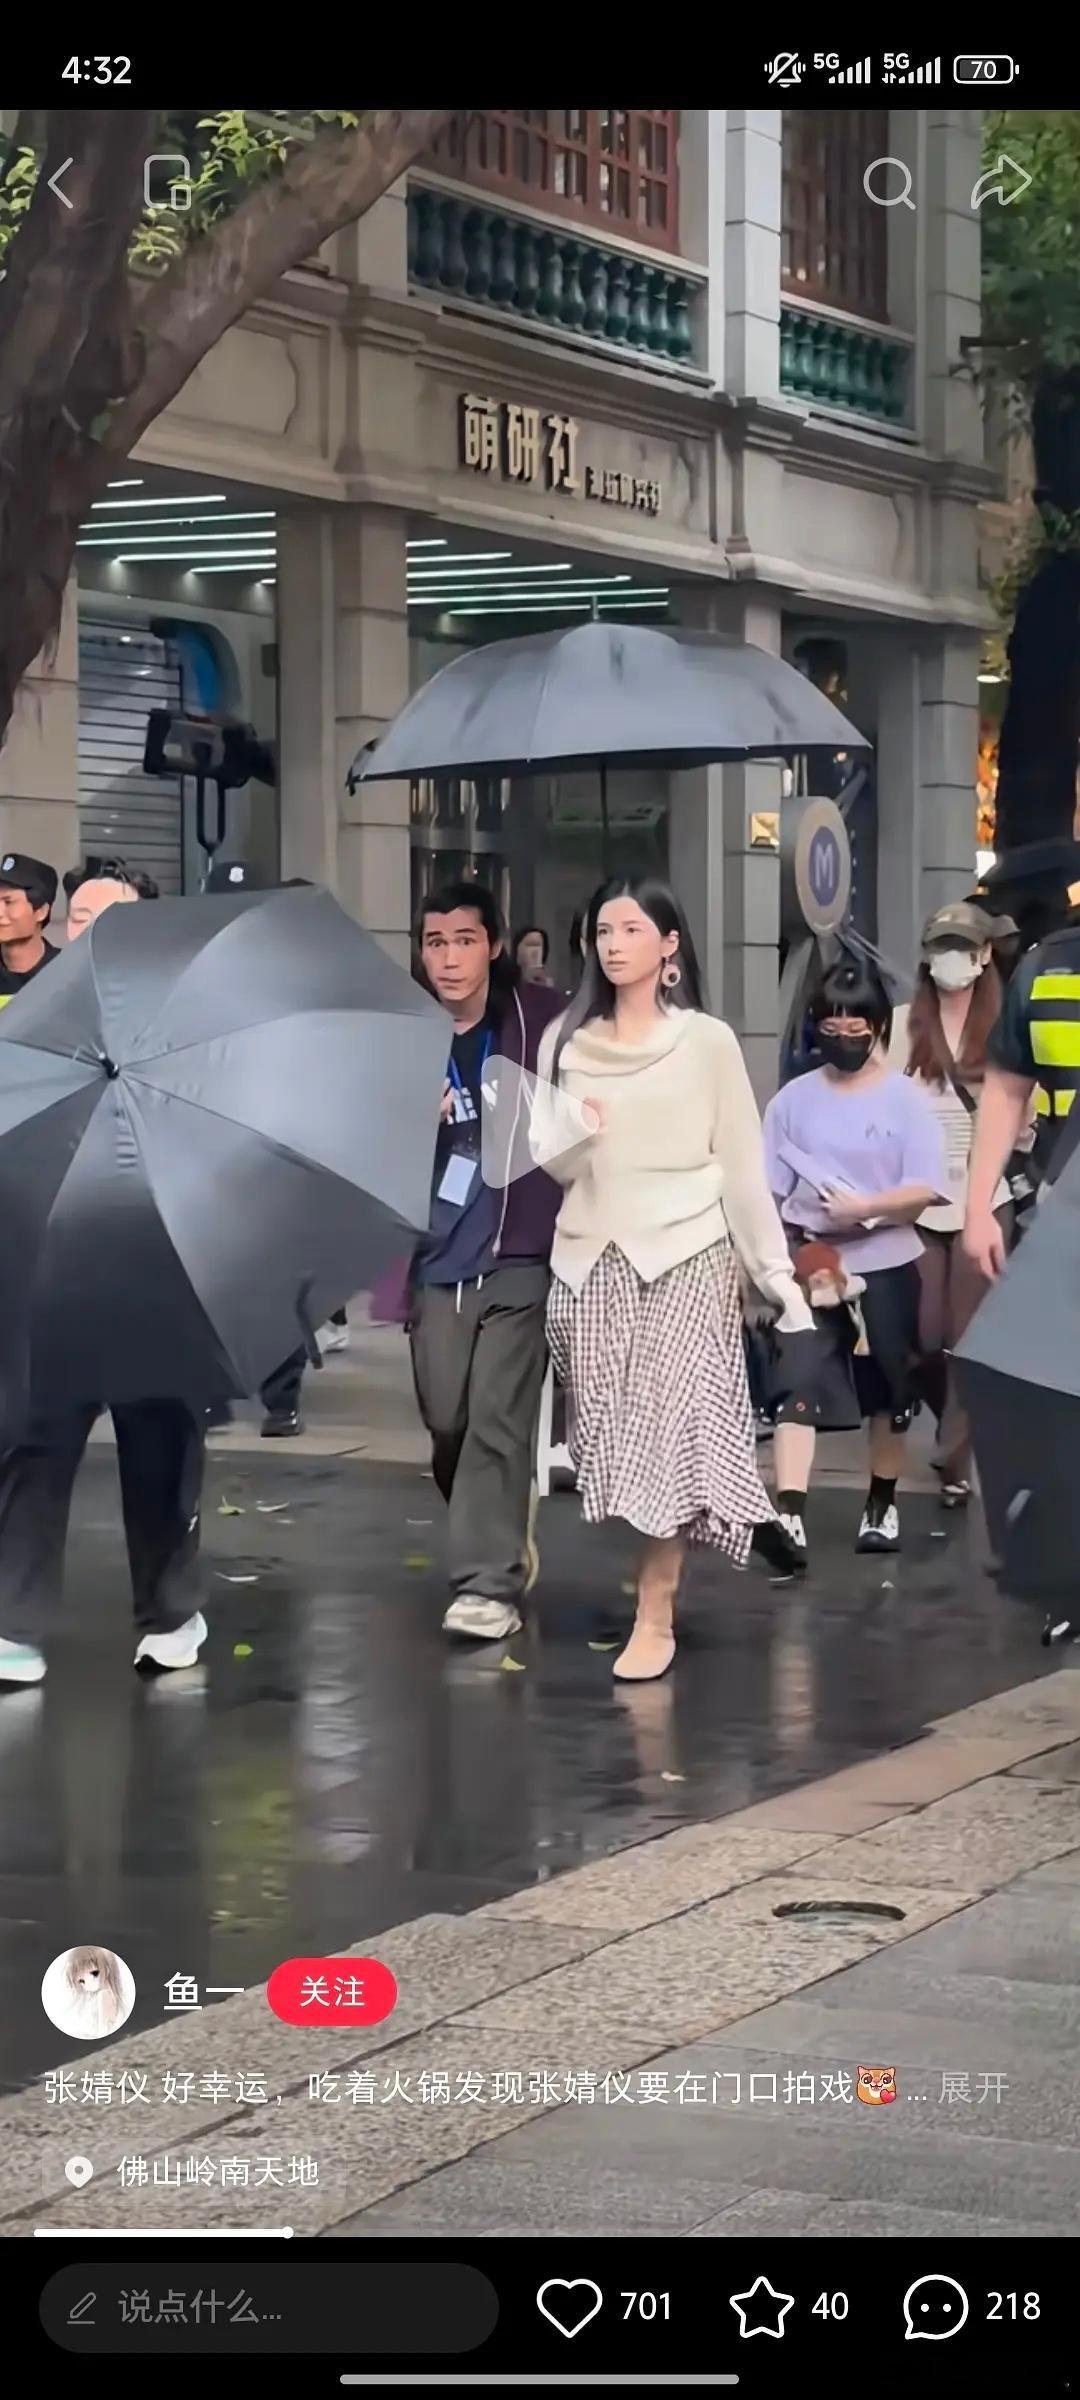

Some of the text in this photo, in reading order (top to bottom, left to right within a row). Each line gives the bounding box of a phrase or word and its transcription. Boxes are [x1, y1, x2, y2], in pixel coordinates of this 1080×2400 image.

[462, 393, 581, 490] 萌研社
[815, 843, 834, 889] M
